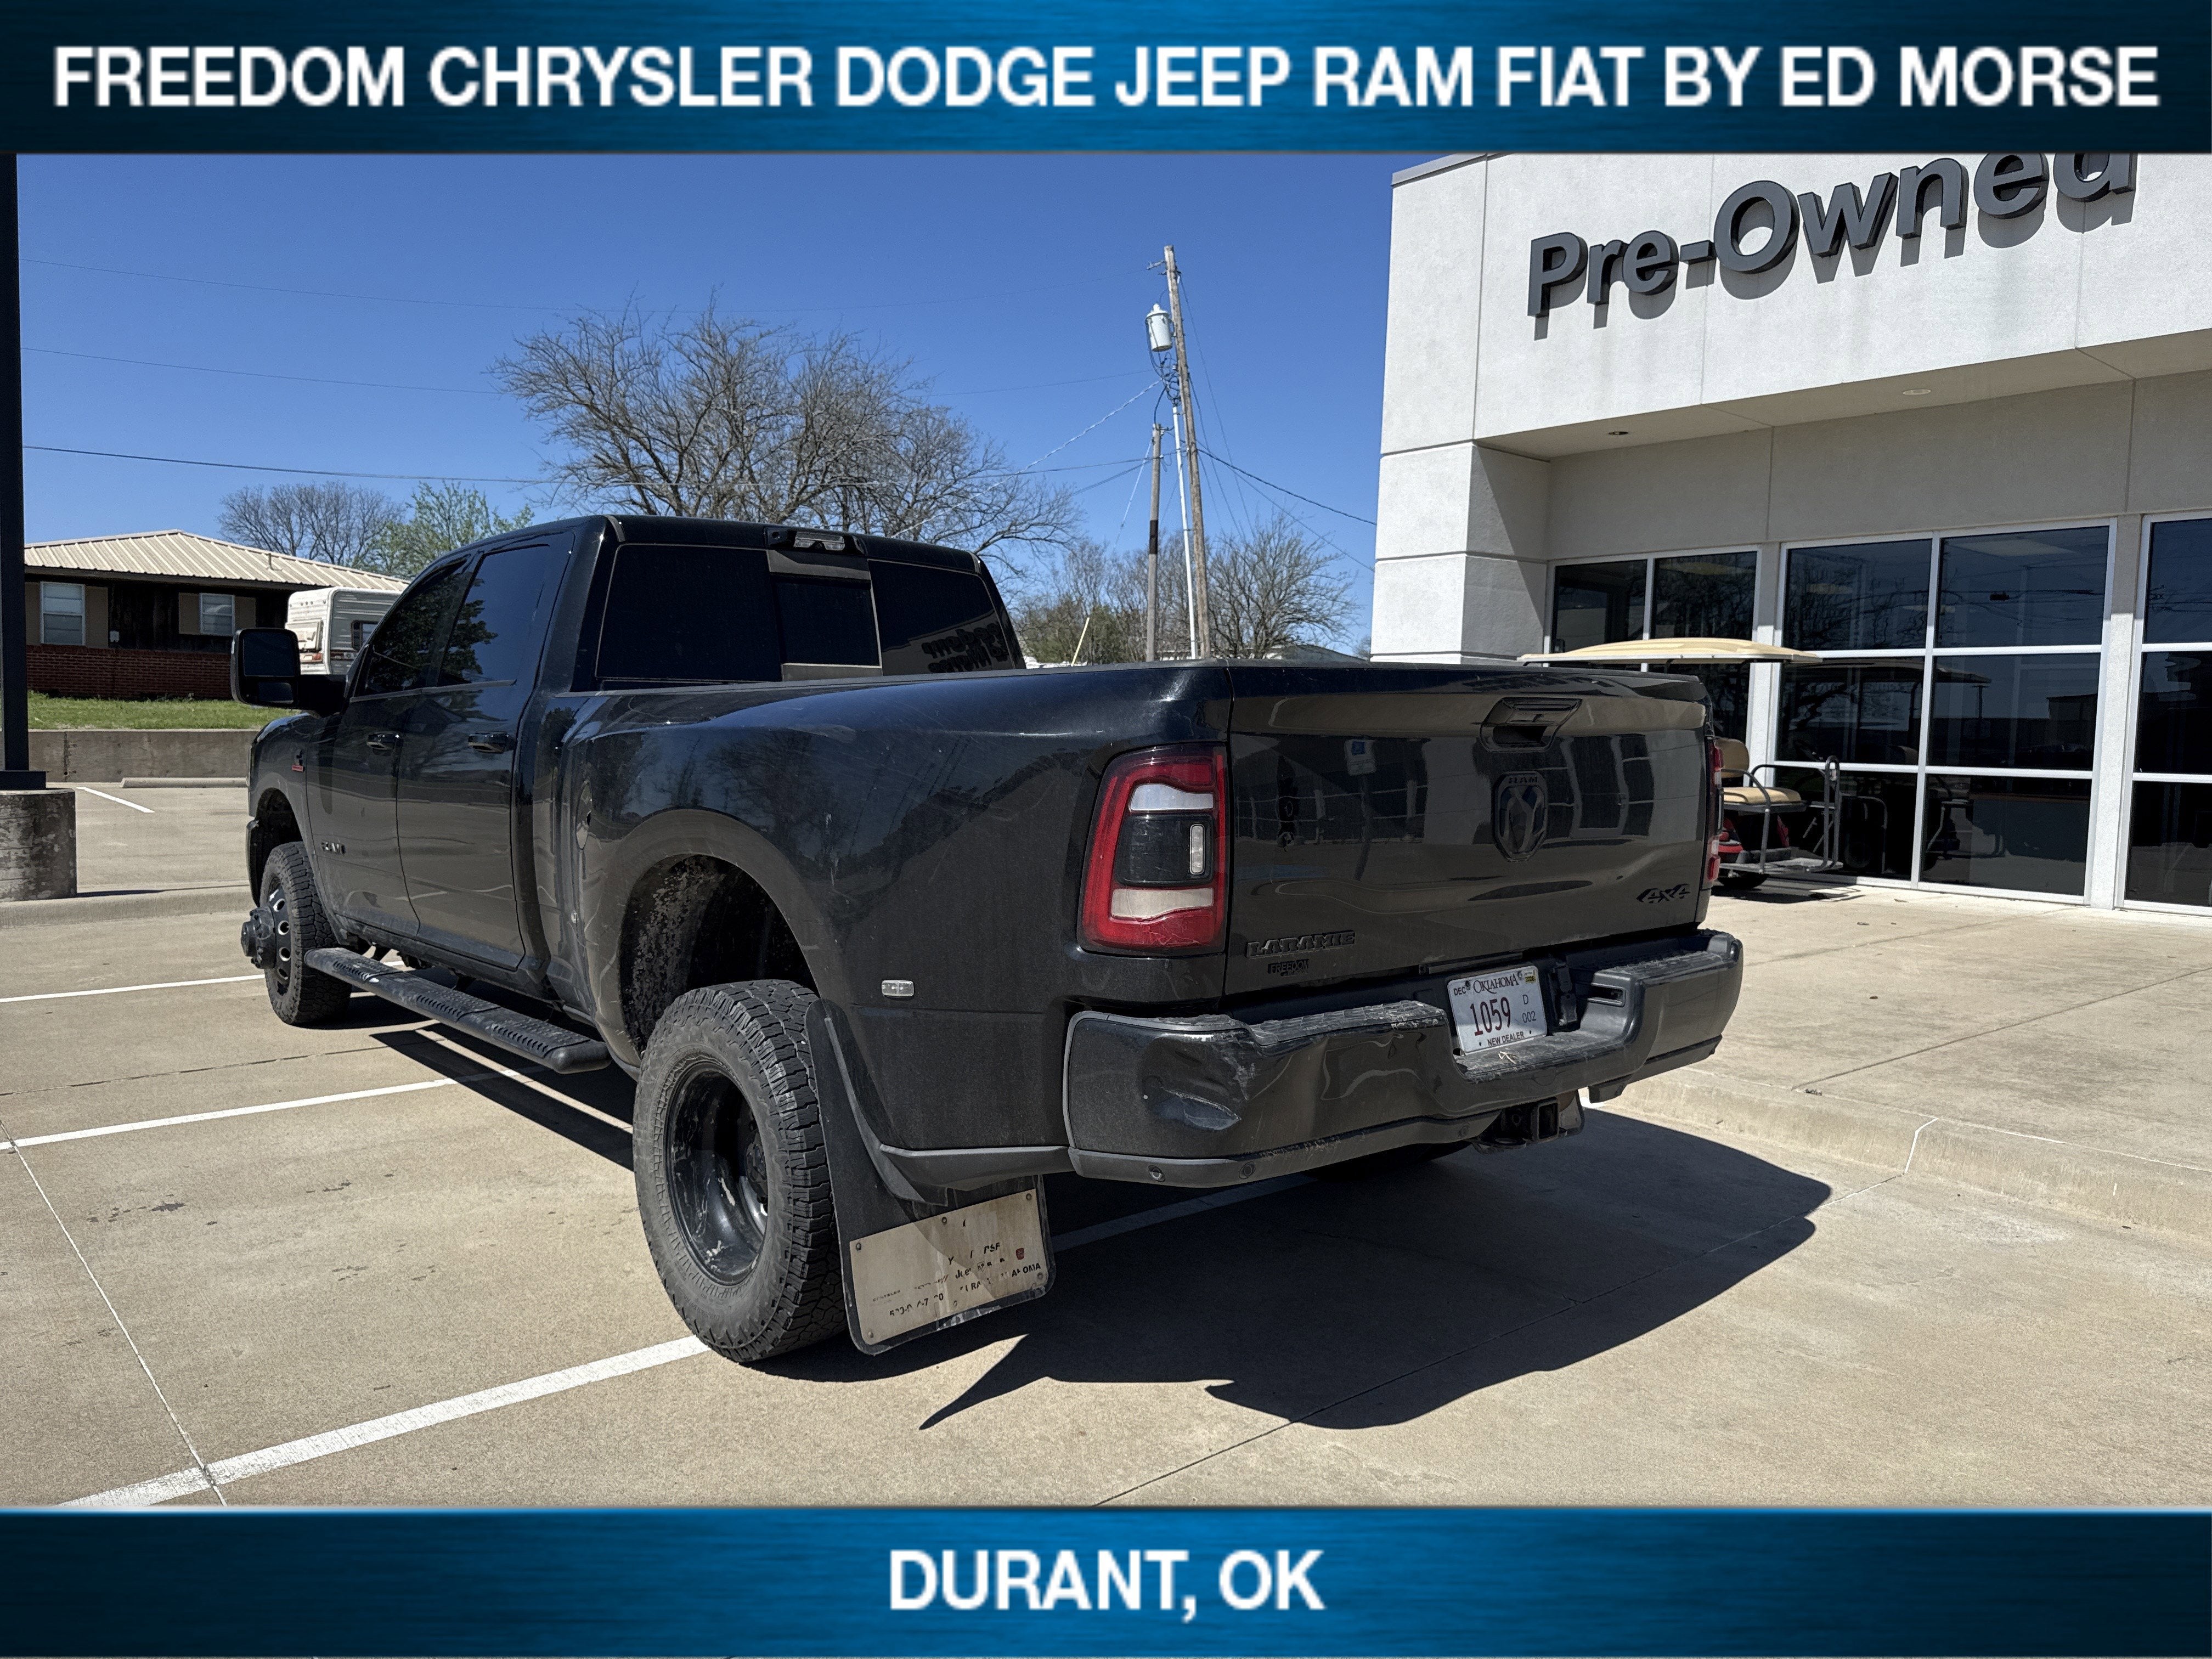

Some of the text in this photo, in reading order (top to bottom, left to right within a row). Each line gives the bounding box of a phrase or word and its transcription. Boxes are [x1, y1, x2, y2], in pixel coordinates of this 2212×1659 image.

[1528, 153, 2136, 318] Pre-Owned
[1246, 930, 1356, 958] LARAMIE
[1267, 959, 1310, 974] FREEDOM
[1454, 973, 1519, 996] DEC OKLAHOMA
[1523, 994, 1529, 1005] D
[1470, 997, 1511, 1036] 1059
[1522, 1011, 1536, 1023] 002
[1487, 1031, 1525, 1047] NEW DEALER
